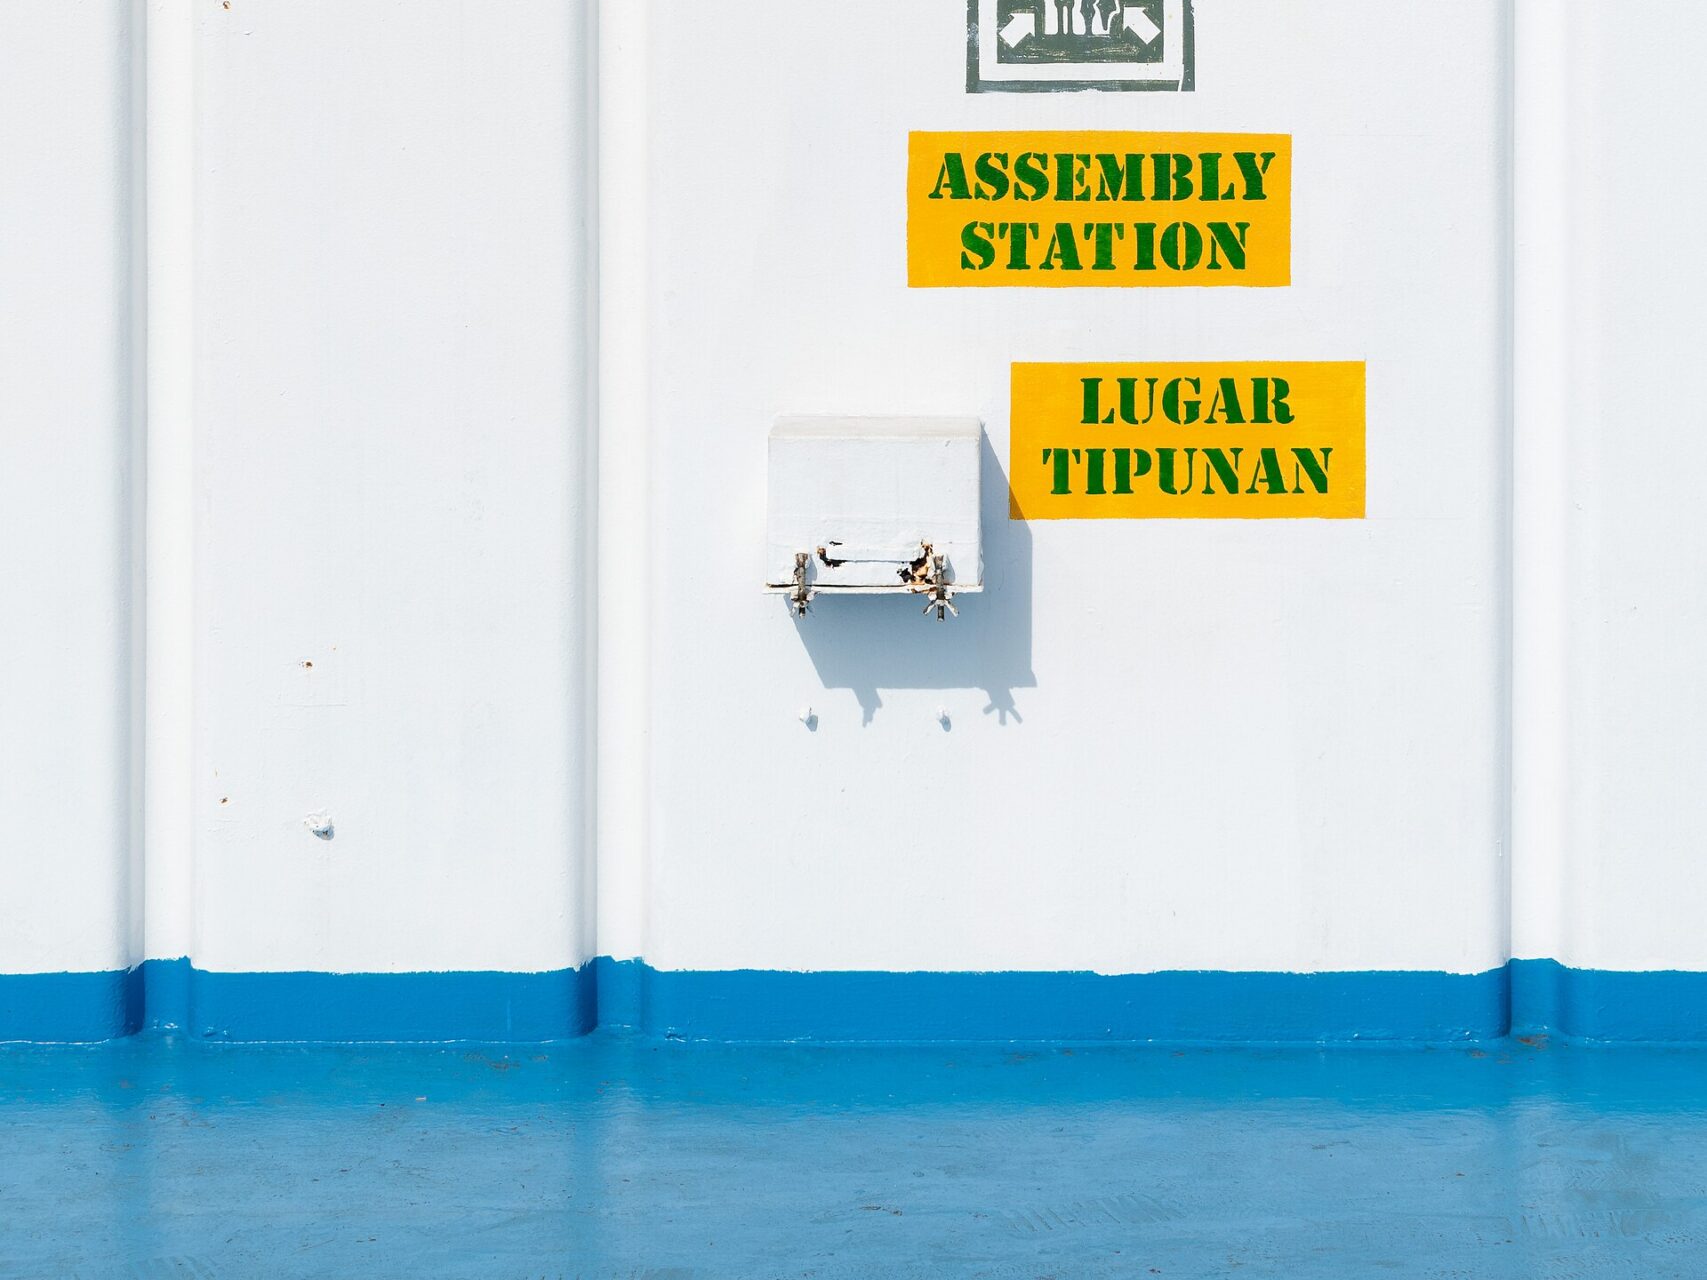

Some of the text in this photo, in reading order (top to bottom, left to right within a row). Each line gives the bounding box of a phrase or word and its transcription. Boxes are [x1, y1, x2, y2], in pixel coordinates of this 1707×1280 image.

[928, 152, 1276, 202] ASSEMBLY
[961, 221, 1252, 272] STATION
[1080, 377, 1297, 426] LUGAR
[1042, 448, 1334, 496] TIPUNAN
